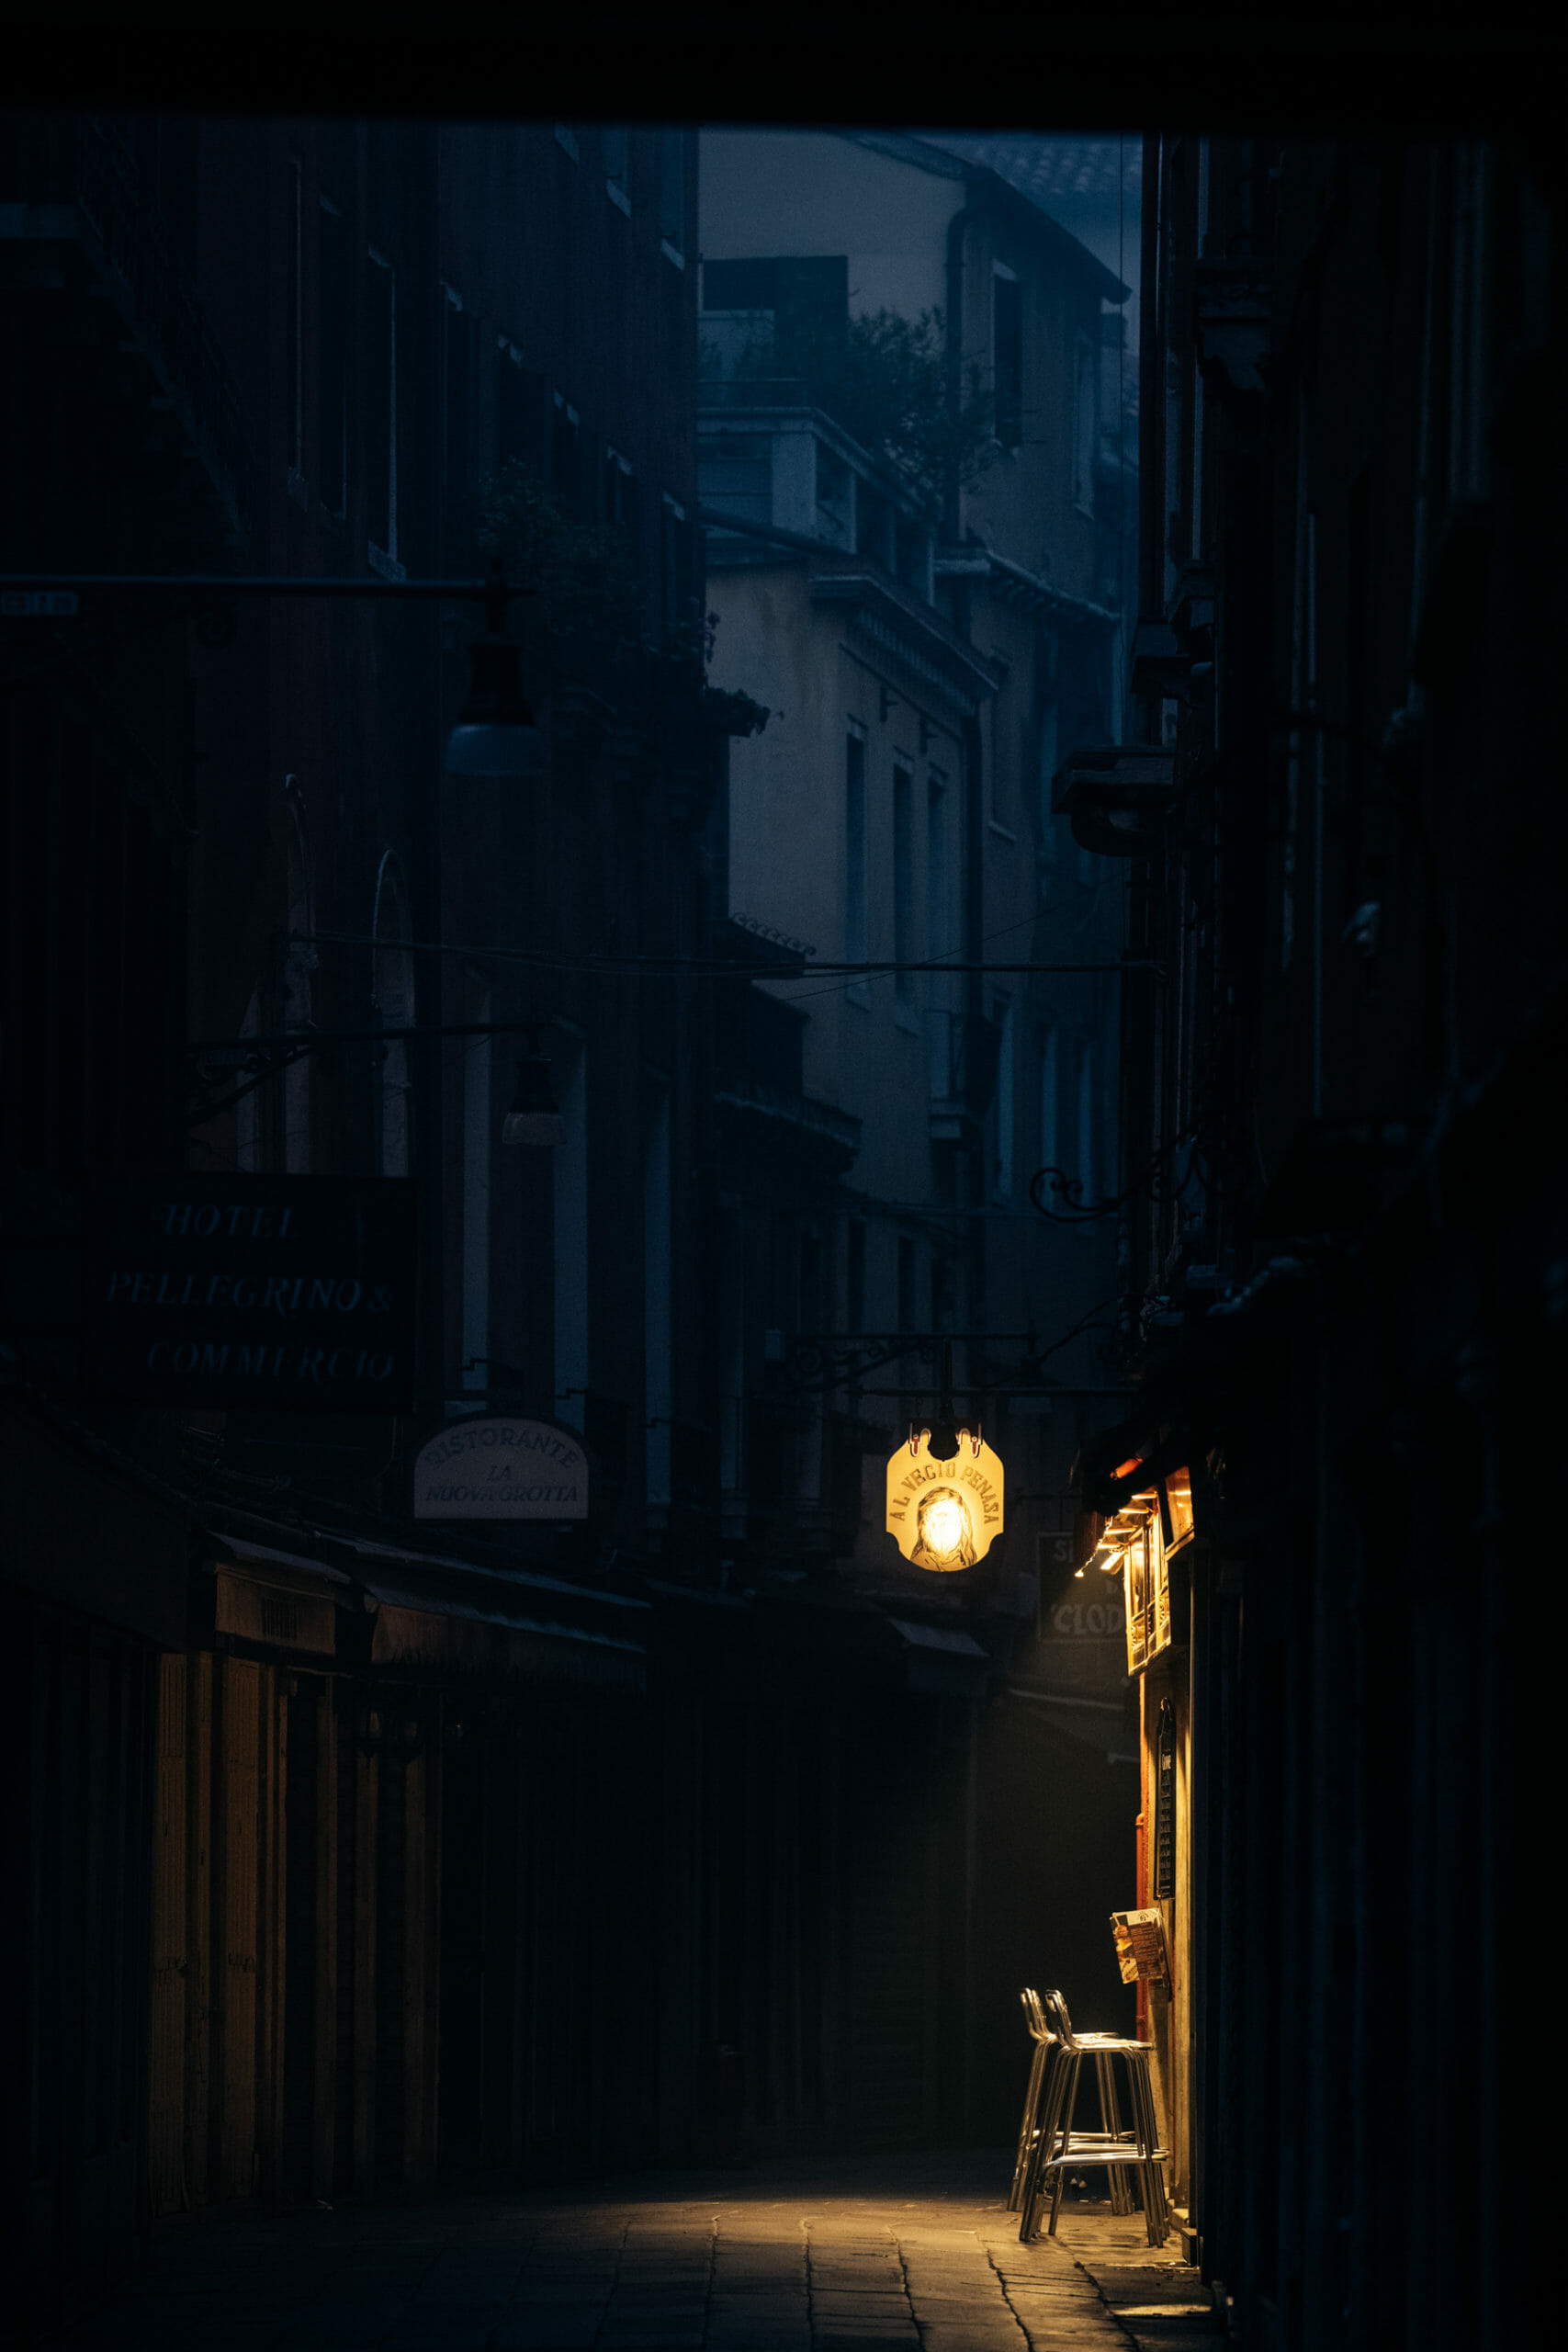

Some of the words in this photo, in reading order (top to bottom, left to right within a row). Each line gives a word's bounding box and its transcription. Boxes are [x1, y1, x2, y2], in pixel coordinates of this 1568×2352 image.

[164, 1204, 300, 1241] HOTEL
[106, 1271, 361, 1319] PELLEGRINO
[147, 1340, 395, 1386] COMMERCIO
[425, 1428, 579, 1469] RISTORANTE
[488, 1465, 513, 1481] LA
[888, 1497, 910, 1521] AL
[901, 1462, 955, 1491] VECIO
[960, 1465, 999, 1524] PENASA
[426, 1486, 494, 1502] NUOVA
[499, 1486, 578, 1502] GROTTA
